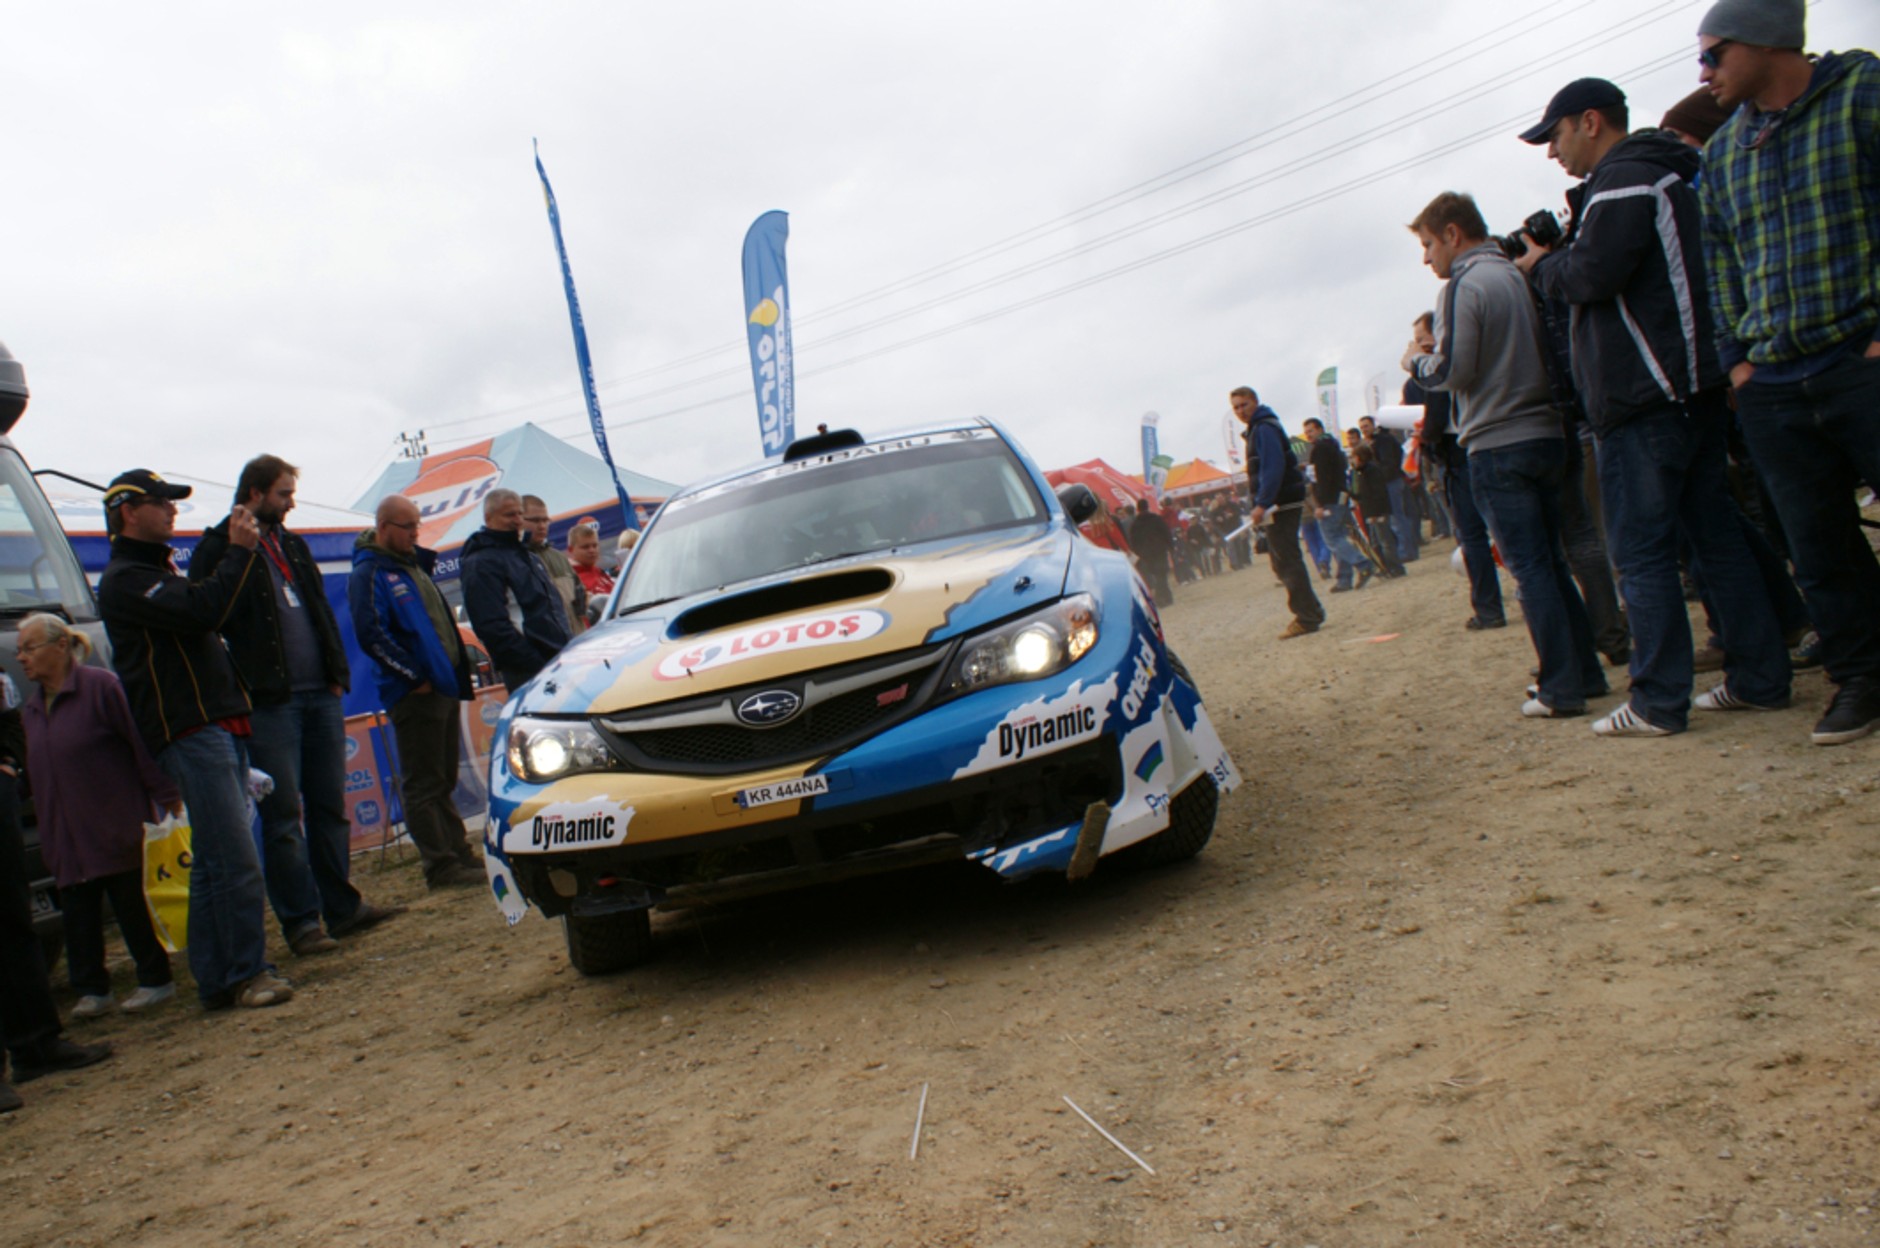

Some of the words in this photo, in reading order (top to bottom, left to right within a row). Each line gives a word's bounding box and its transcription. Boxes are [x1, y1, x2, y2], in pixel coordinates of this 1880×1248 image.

[420, 476, 497, 517] ulf
[730, 615, 862, 655] LOTOS
[999, 705, 1095, 759] Dynamic
[749, 788, 772, 803] KR
[776, 777, 825, 798] 444NA
[532, 813, 615, 851] Dynamic
